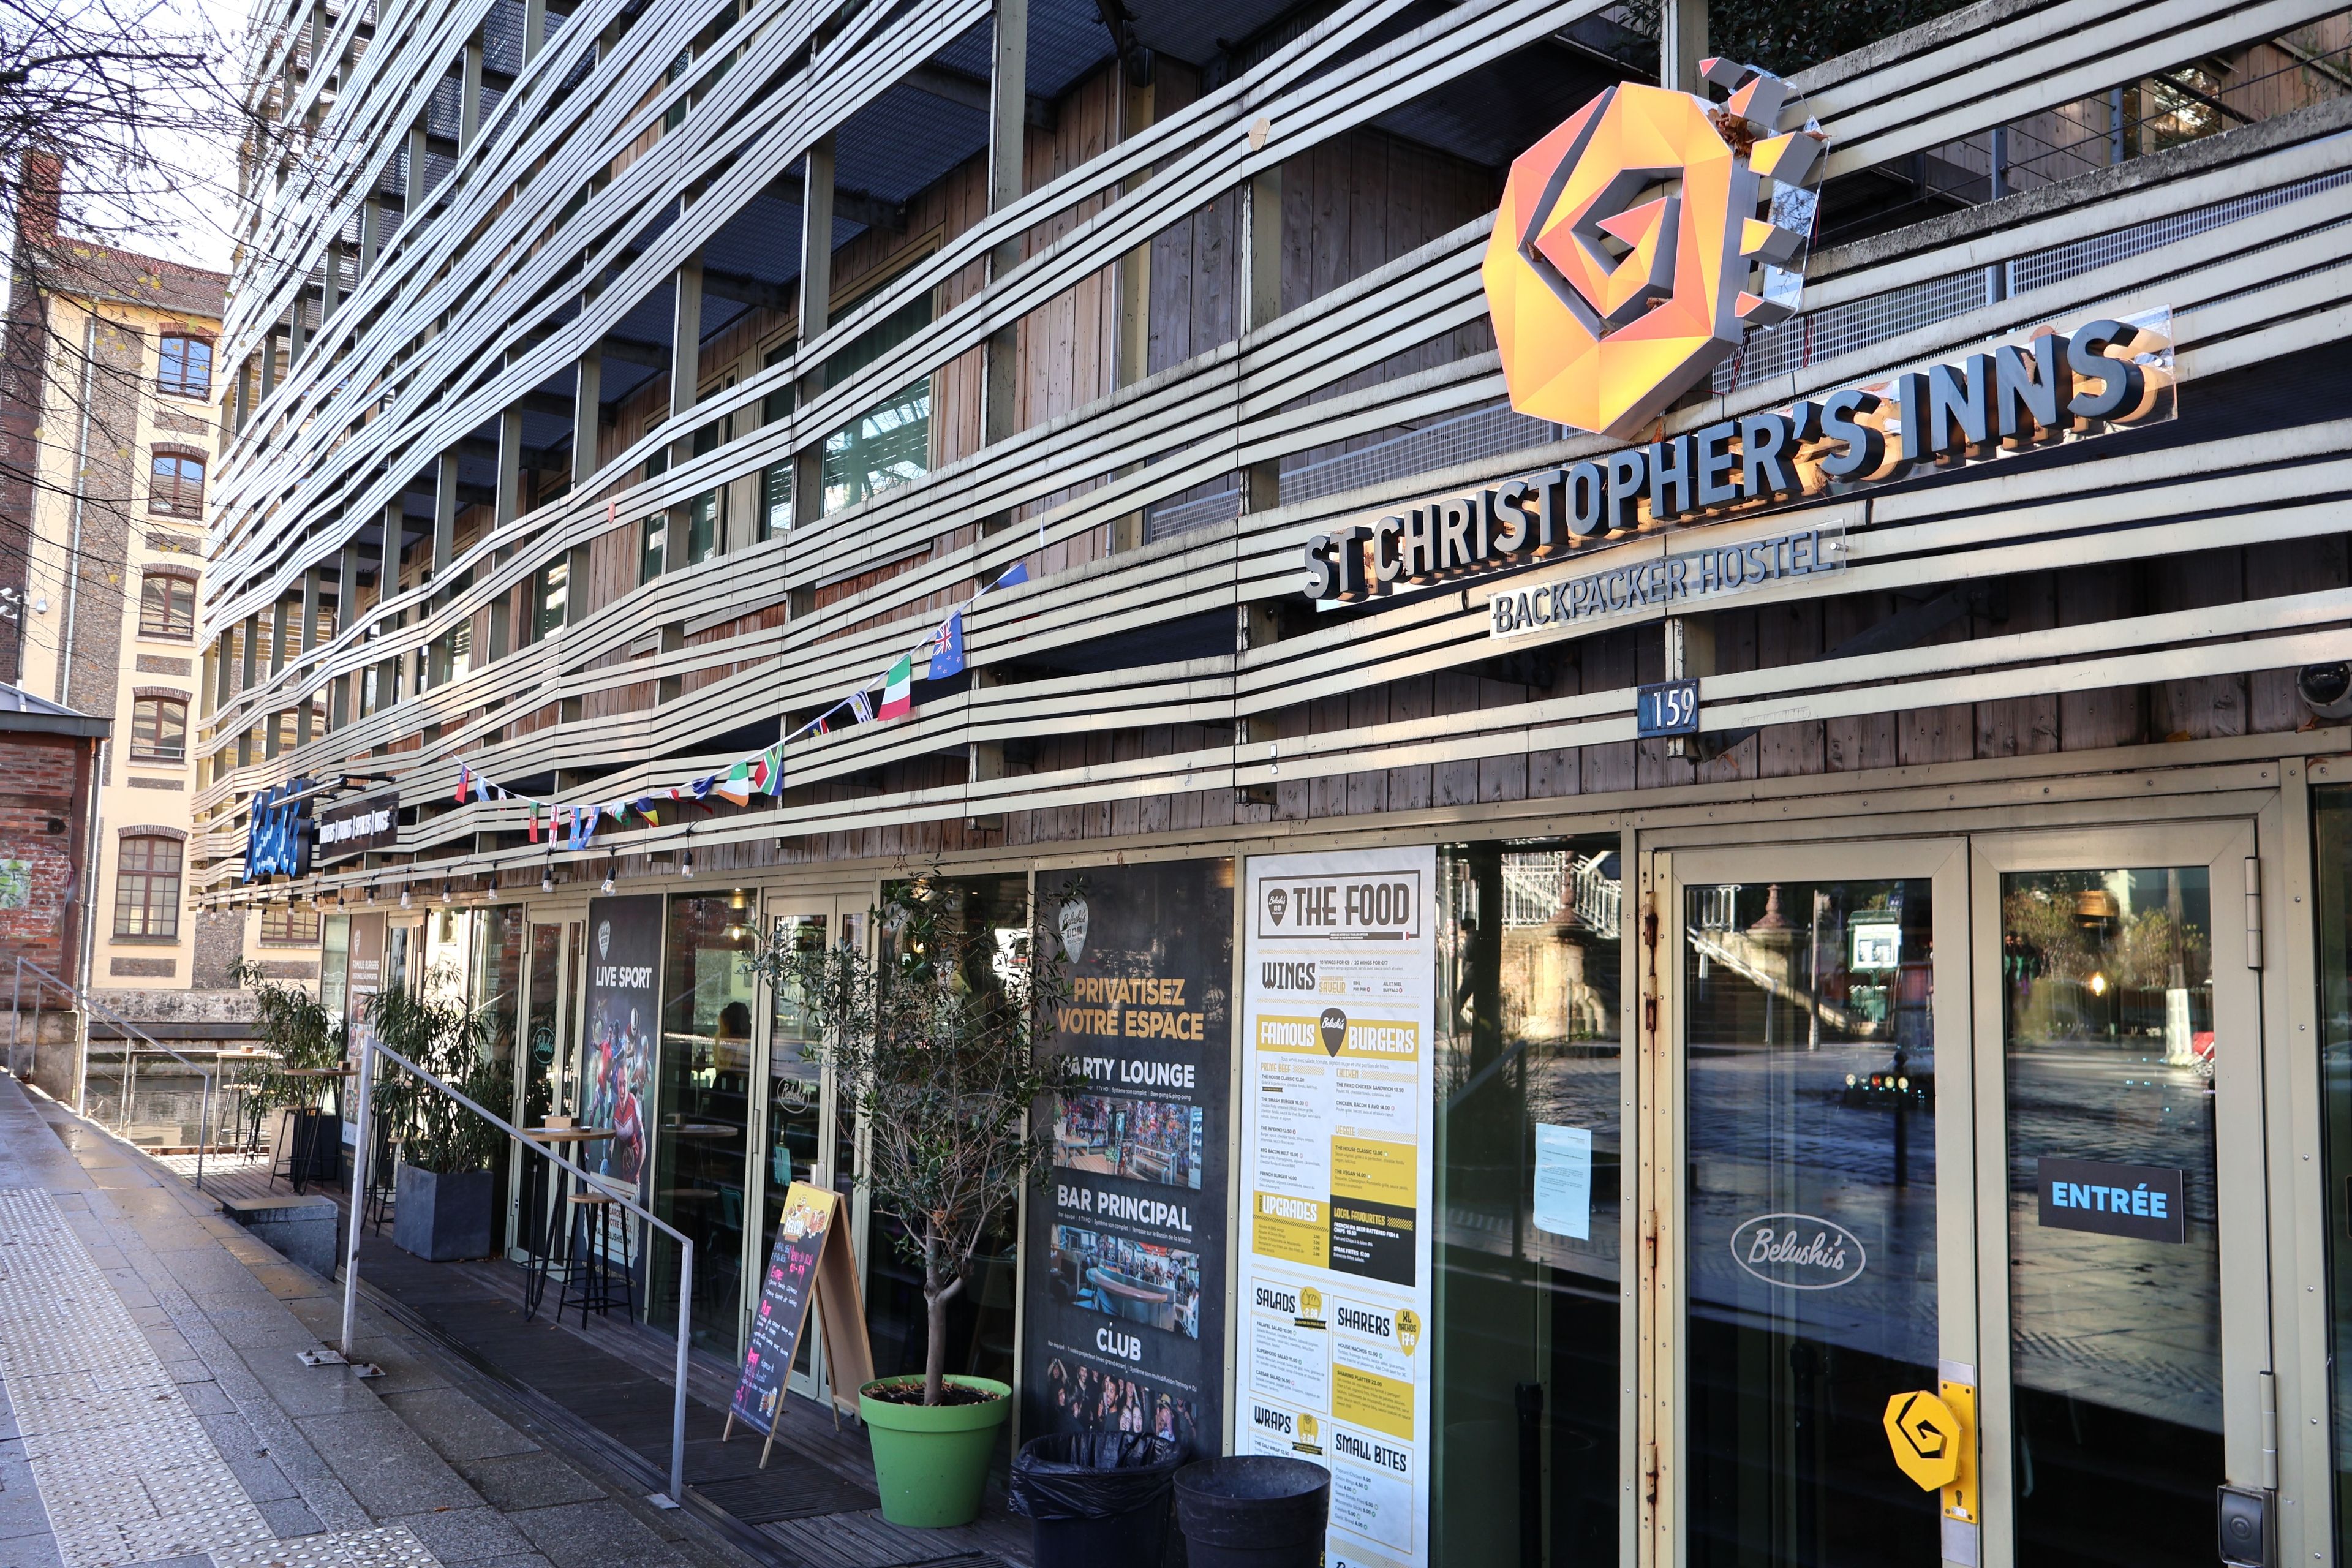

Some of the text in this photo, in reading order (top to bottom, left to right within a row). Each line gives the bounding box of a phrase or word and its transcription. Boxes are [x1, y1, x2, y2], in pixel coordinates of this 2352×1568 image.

[1303, 319, 2144, 601] ST CHRISTOPHER'S INNS
[1496, 530, 1831, 633] BACKPACKER HOSTEL
[1654, 688, 1694, 728] 159
[1293, 883, 1409, 926] THE FOOD
[1062, 911, 1087, 928] Belushi's
[595, 966, 652, 989] LIVE SPORT
[1262, 962, 1316, 990] WINGS
[1319, 981, 1346, 993] SAVEUR
[1074, 978, 1186, 1006] PRIVATISEZ
[1057, 1008, 1204, 1040] VOTRE ESPACE
[1321, 1017, 1344, 1030] Belushi's
[1261, 1021, 1414, 1054] FAMOUS BURGERS
[1121, 1060, 1195, 1088] LOUNGE
[1261, 1063, 1291, 1072] PRIME BEEF
[1336, 1068, 1359, 1078] CHICKEN
[781, 1082, 805, 1105] Belushi's
[1150, 1090, 1169, 1099] Beer-pong
[1335, 1125, 1355, 1136] VEGGIE
[1058, 1184, 1192, 1232] BAR PRINCIPAL
[1262, 1194, 1317, 1223] UPGRADES
[2052, 1181, 2168, 1219] ENTRÉE
[1333, 1207, 1385, 1226] LOCAL FAVOURITES
[1333, 1221, 1349, 1230] FRENCH
[1366, 1227, 1385, 1237] BATTERED
[1094, 1219, 1107, 1227] Système
[1115, 1223, 1128, 1231] complet
[1131, 1226, 1146, 1235] Terrasse
[1156, 1231, 1167, 1240] Bassin
[1177, 1235, 1191, 1245] Villette
[1748, 1227, 1846, 1271] Belushi's
[1257, 1287, 1295, 1313] SALADS
[1338, 1306, 1390, 1337] SHARERS
[1398, 1322, 1417, 1333] NACHOS
[1403, 1311, 1412, 1323] XL
[1096, 1327, 1141, 1361] CLUB
[1079, 1349, 1095, 1360] projecteur
[1095, 1354, 1104, 1363] (avec
[1104, 1357, 1115, 1366] grand
[1129, 1365, 1144, 1376] Système
[1337, 1370, 1354, 1379] SHARING
[1354, 1374, 1371, 1383] PLATTER
[1254, 1405, 1291, 1434] WRAPS
[1336, 1433, 1371, 1461] SMALL
[1374, 1445, 1406, 1472] BITES
